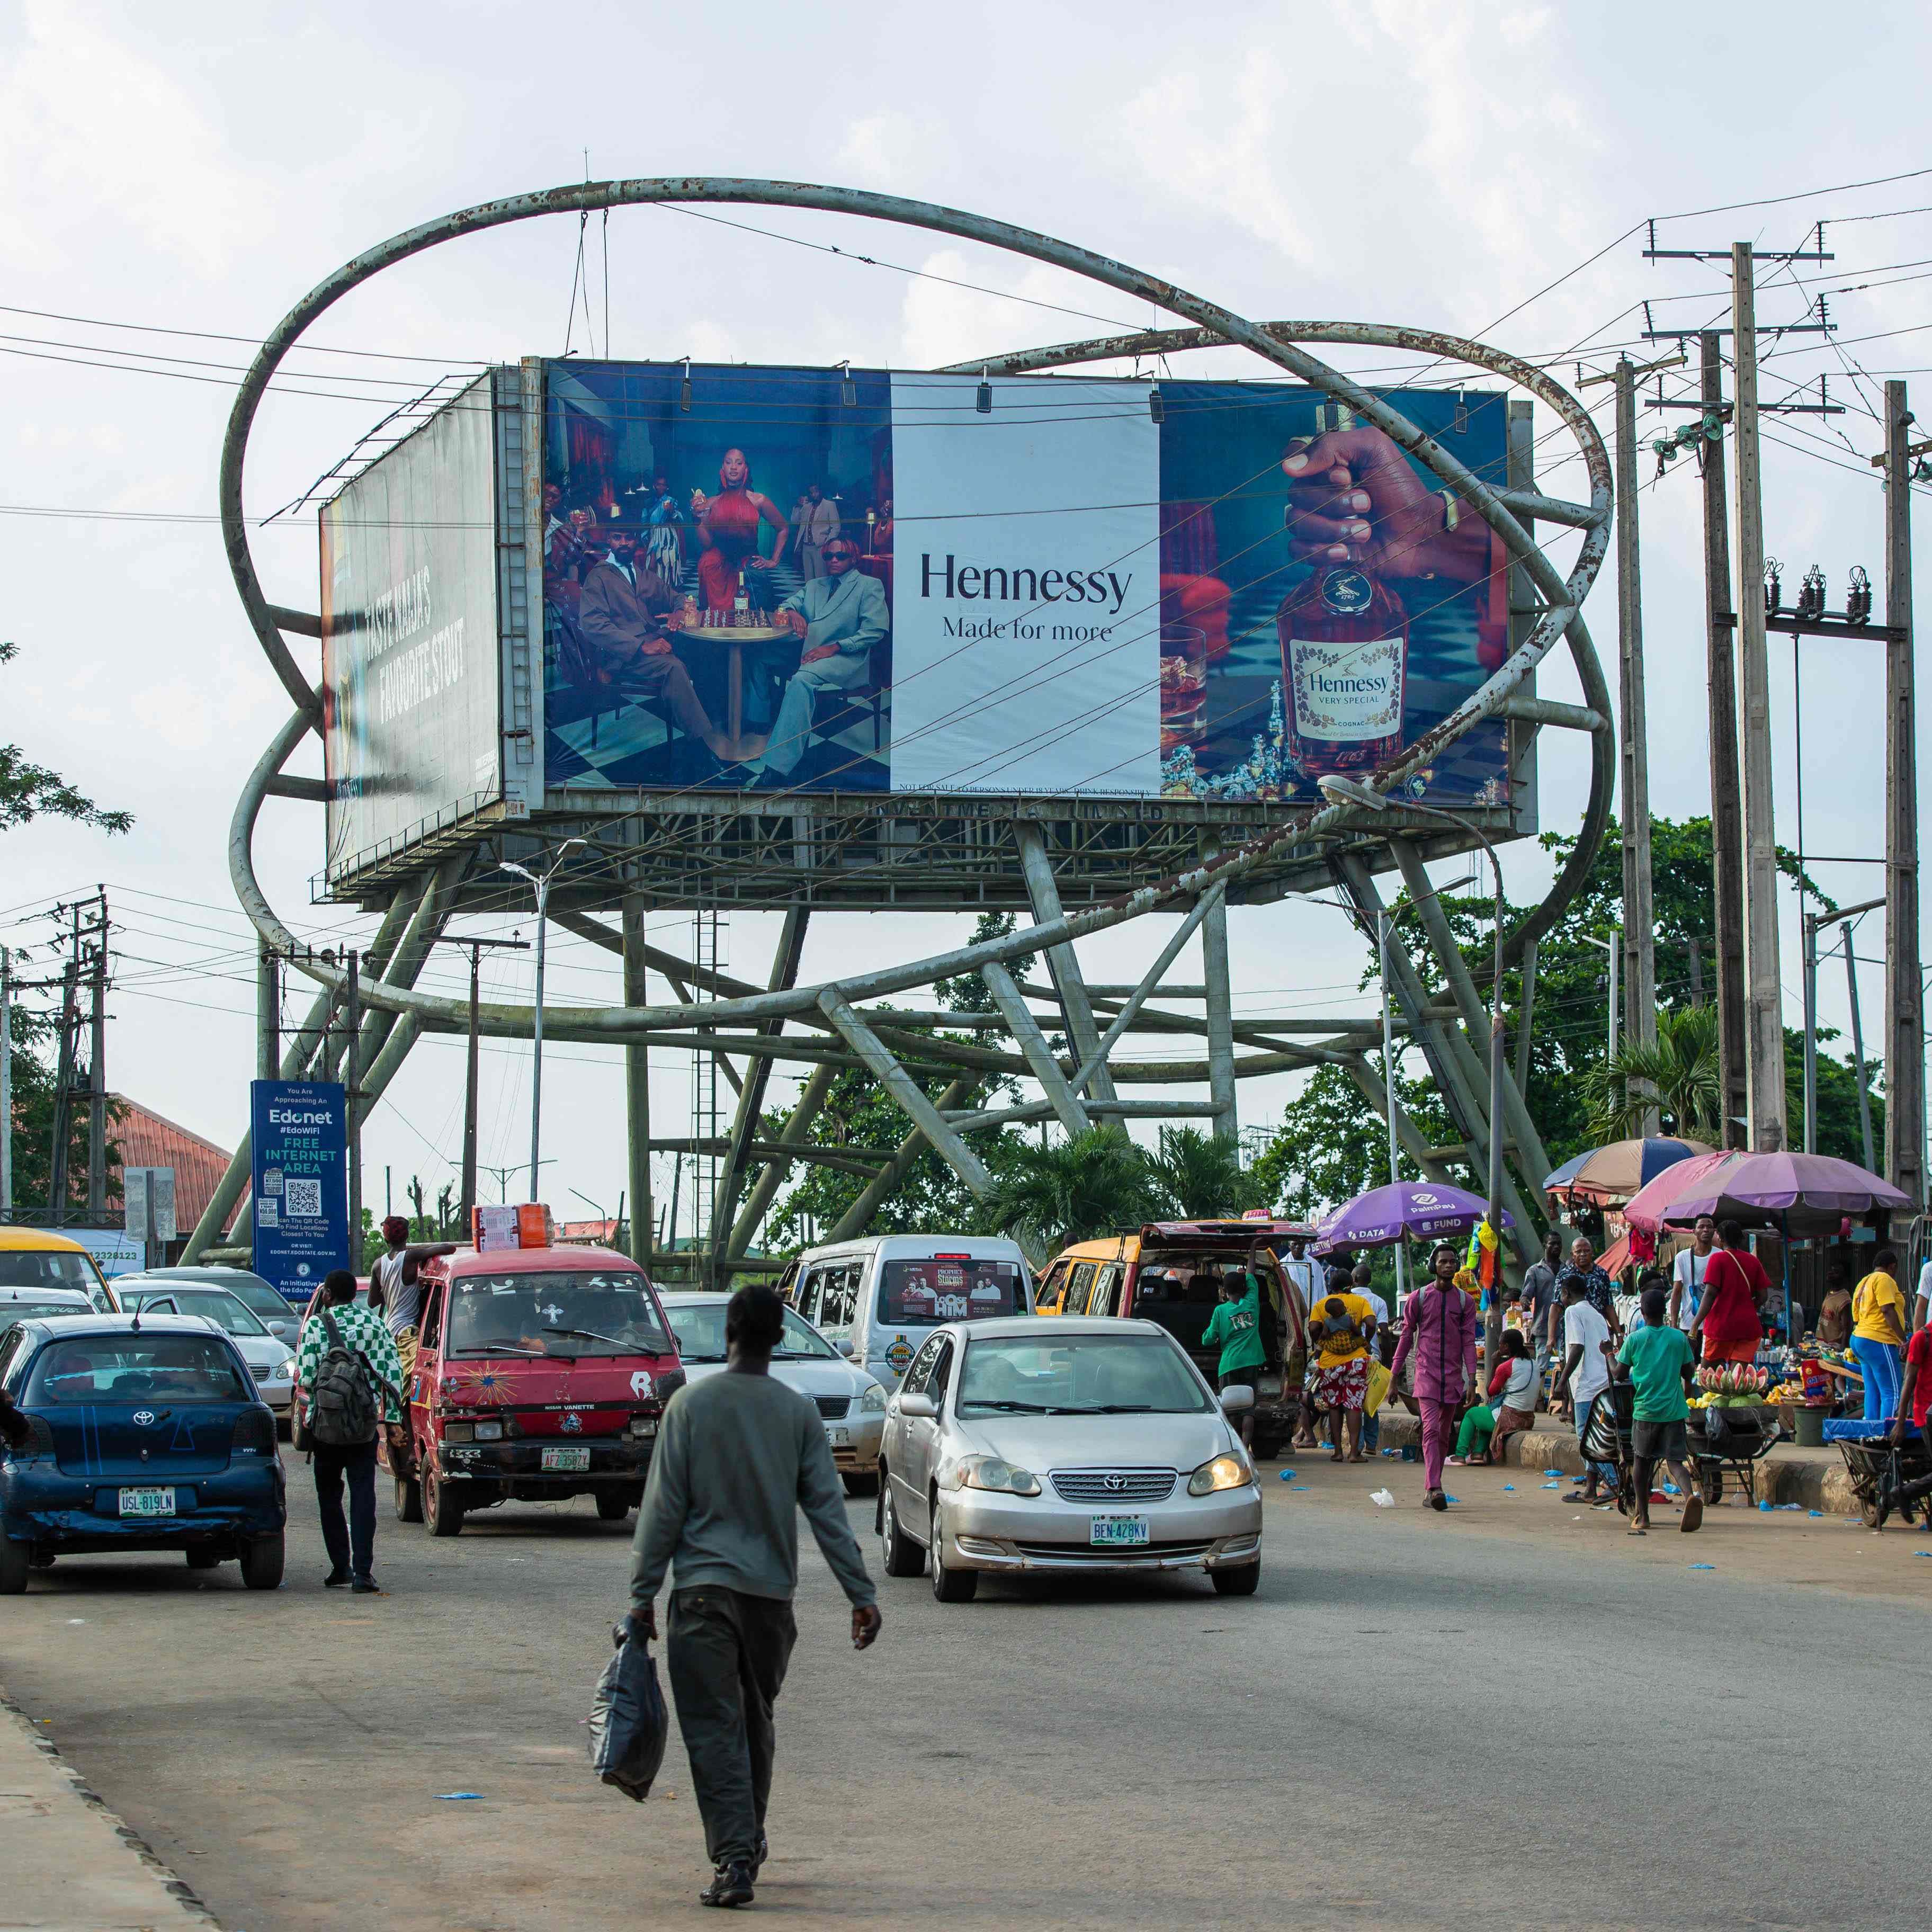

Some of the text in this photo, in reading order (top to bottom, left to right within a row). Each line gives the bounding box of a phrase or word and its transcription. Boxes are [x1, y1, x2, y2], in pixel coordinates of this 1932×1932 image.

[920, 553, 1132, 614] Hennessy
[365, 589, 393, 662] TASTE
[942, 616, 1113, 642] Made for more
[379, 617, 464, 724] FAVOURITE STOUT
[1310, 673, 1389, 694] Hennessy
[1344, 696, 1380, 704] SPECIAL
[269, 1109, 333, 1124] Edonet
[284, 1138, 319, 1148] FREE
[265, 1149, 336, 1161] INTERNET
[283, 1162, 321, 1174] AREA
[1410, 1203, 1456, 1213] PalmPay
[1434, 1218, 1462, 1229] FUND
[1359, 1228, 1384, 1238] DATA
[122, 1496, 172, 1510] USL-819LN
[1094, 1523, 1147, 1539] BEN-428KV
